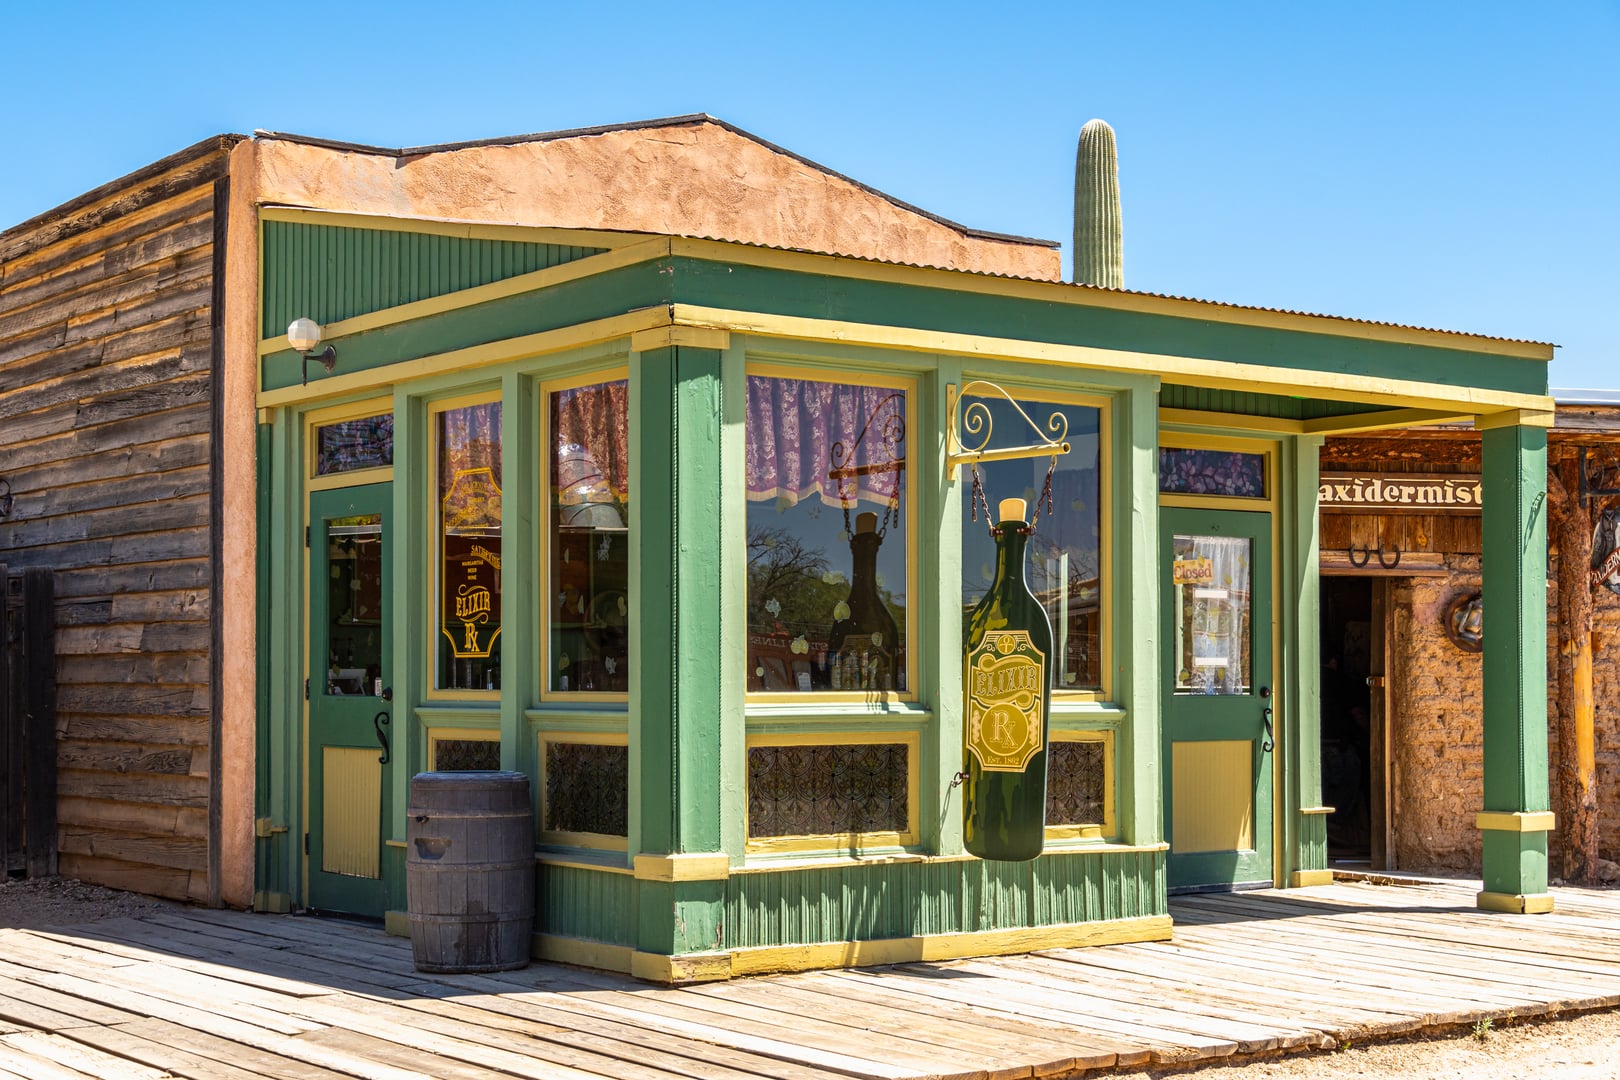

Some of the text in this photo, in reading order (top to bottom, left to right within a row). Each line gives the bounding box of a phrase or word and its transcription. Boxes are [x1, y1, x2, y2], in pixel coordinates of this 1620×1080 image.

[1174, 563, 1213, 580] Closed
[455, 590, 491, 617] ELIXIR
[975, 666, 1038, 697] ELIXIR
